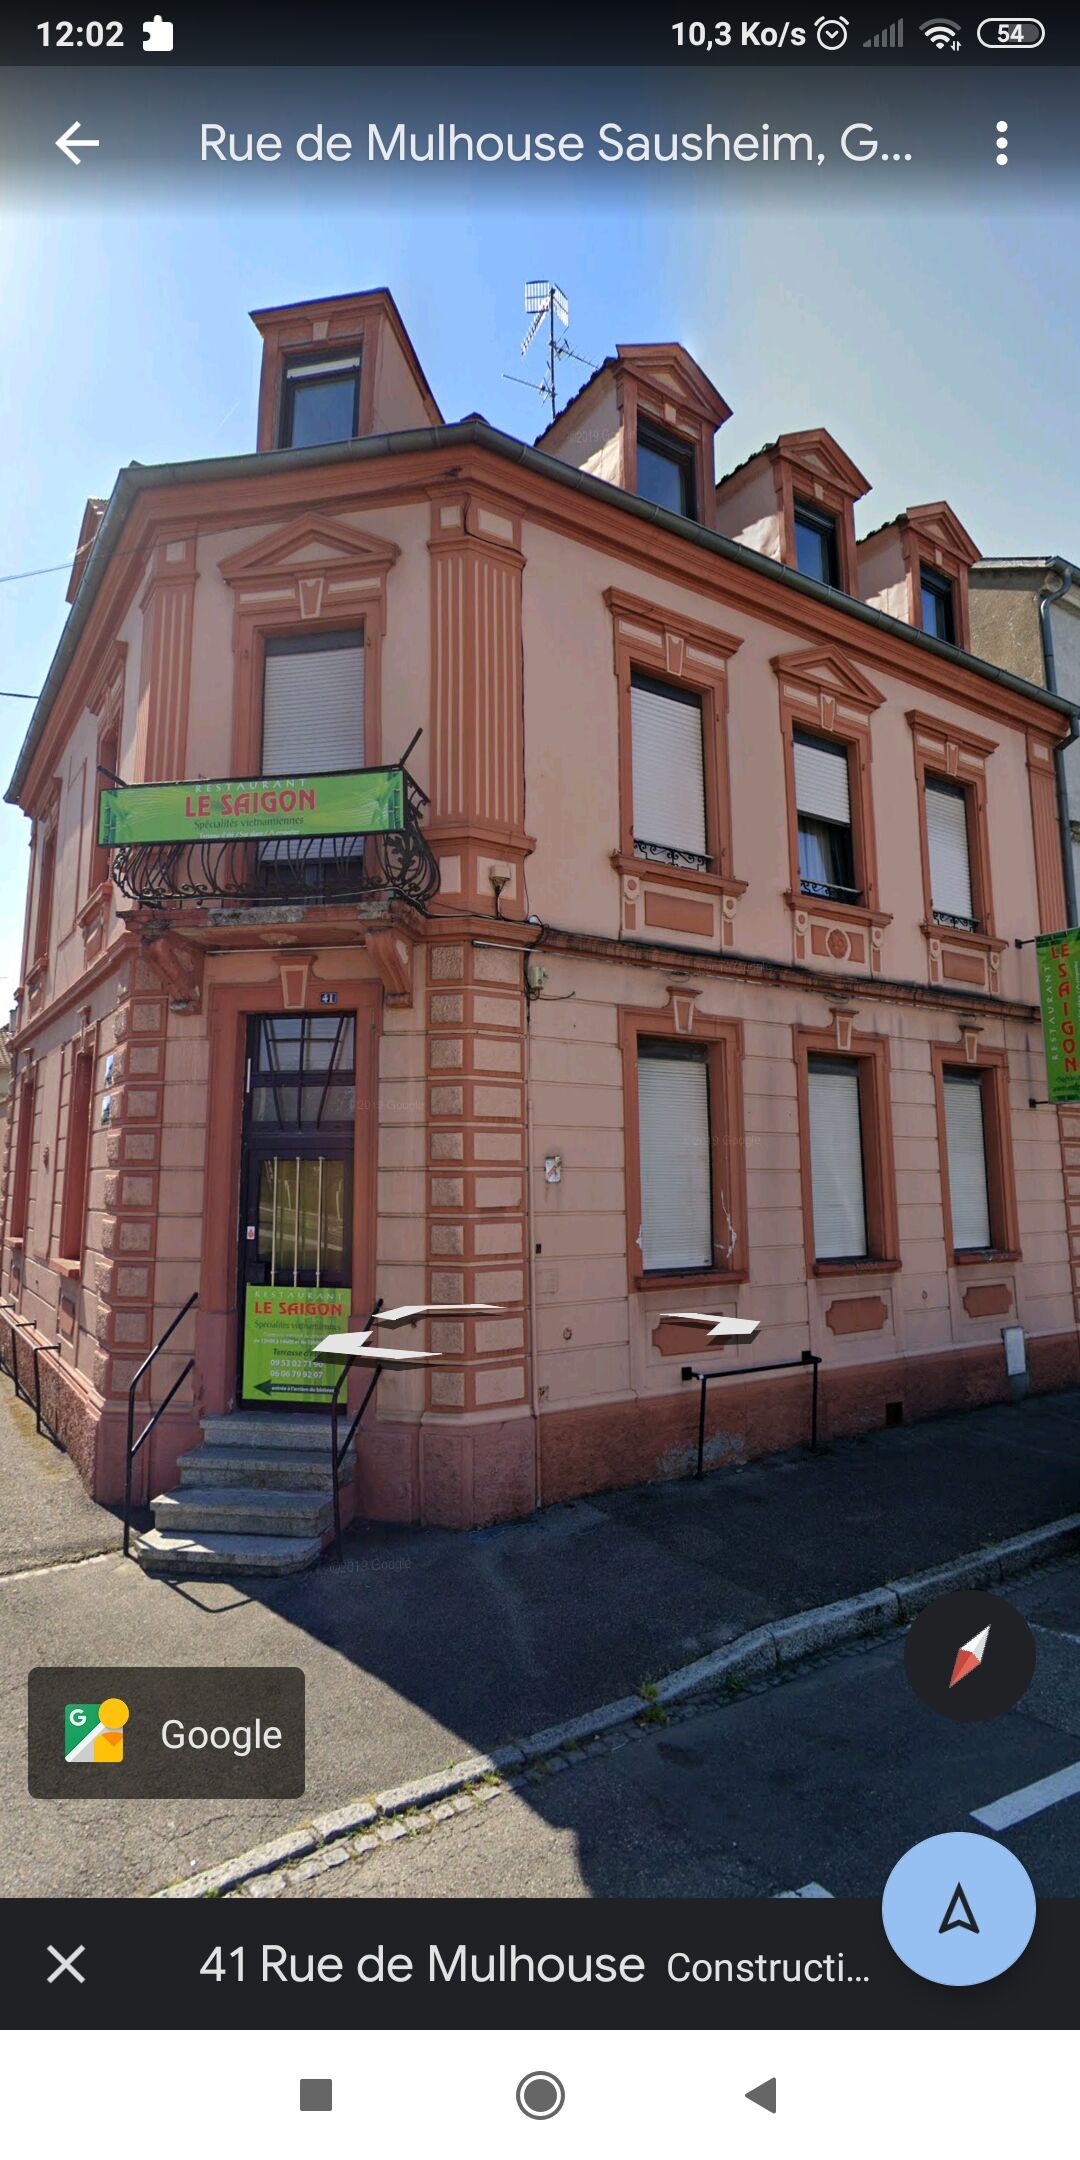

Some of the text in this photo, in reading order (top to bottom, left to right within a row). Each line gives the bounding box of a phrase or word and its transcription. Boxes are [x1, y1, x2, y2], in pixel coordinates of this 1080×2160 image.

[195, 779, 307, 793] RESTAURANT
[185, 788, 316, 818] LE SAIGON
[194, 816, 305, 830] Spécialités vietnamiennes
[1050, 943, 1071, 960] LE
[321, 993, 333, 1003] 41
[1044, 966, 1059, 1060] RESTAURANT
[1057, 962, 1078, 1072] SAIGON
[255, 1290, 343, 1300] RESTAURANT
[255, 1301, 343, 1316] LE SAIGON
